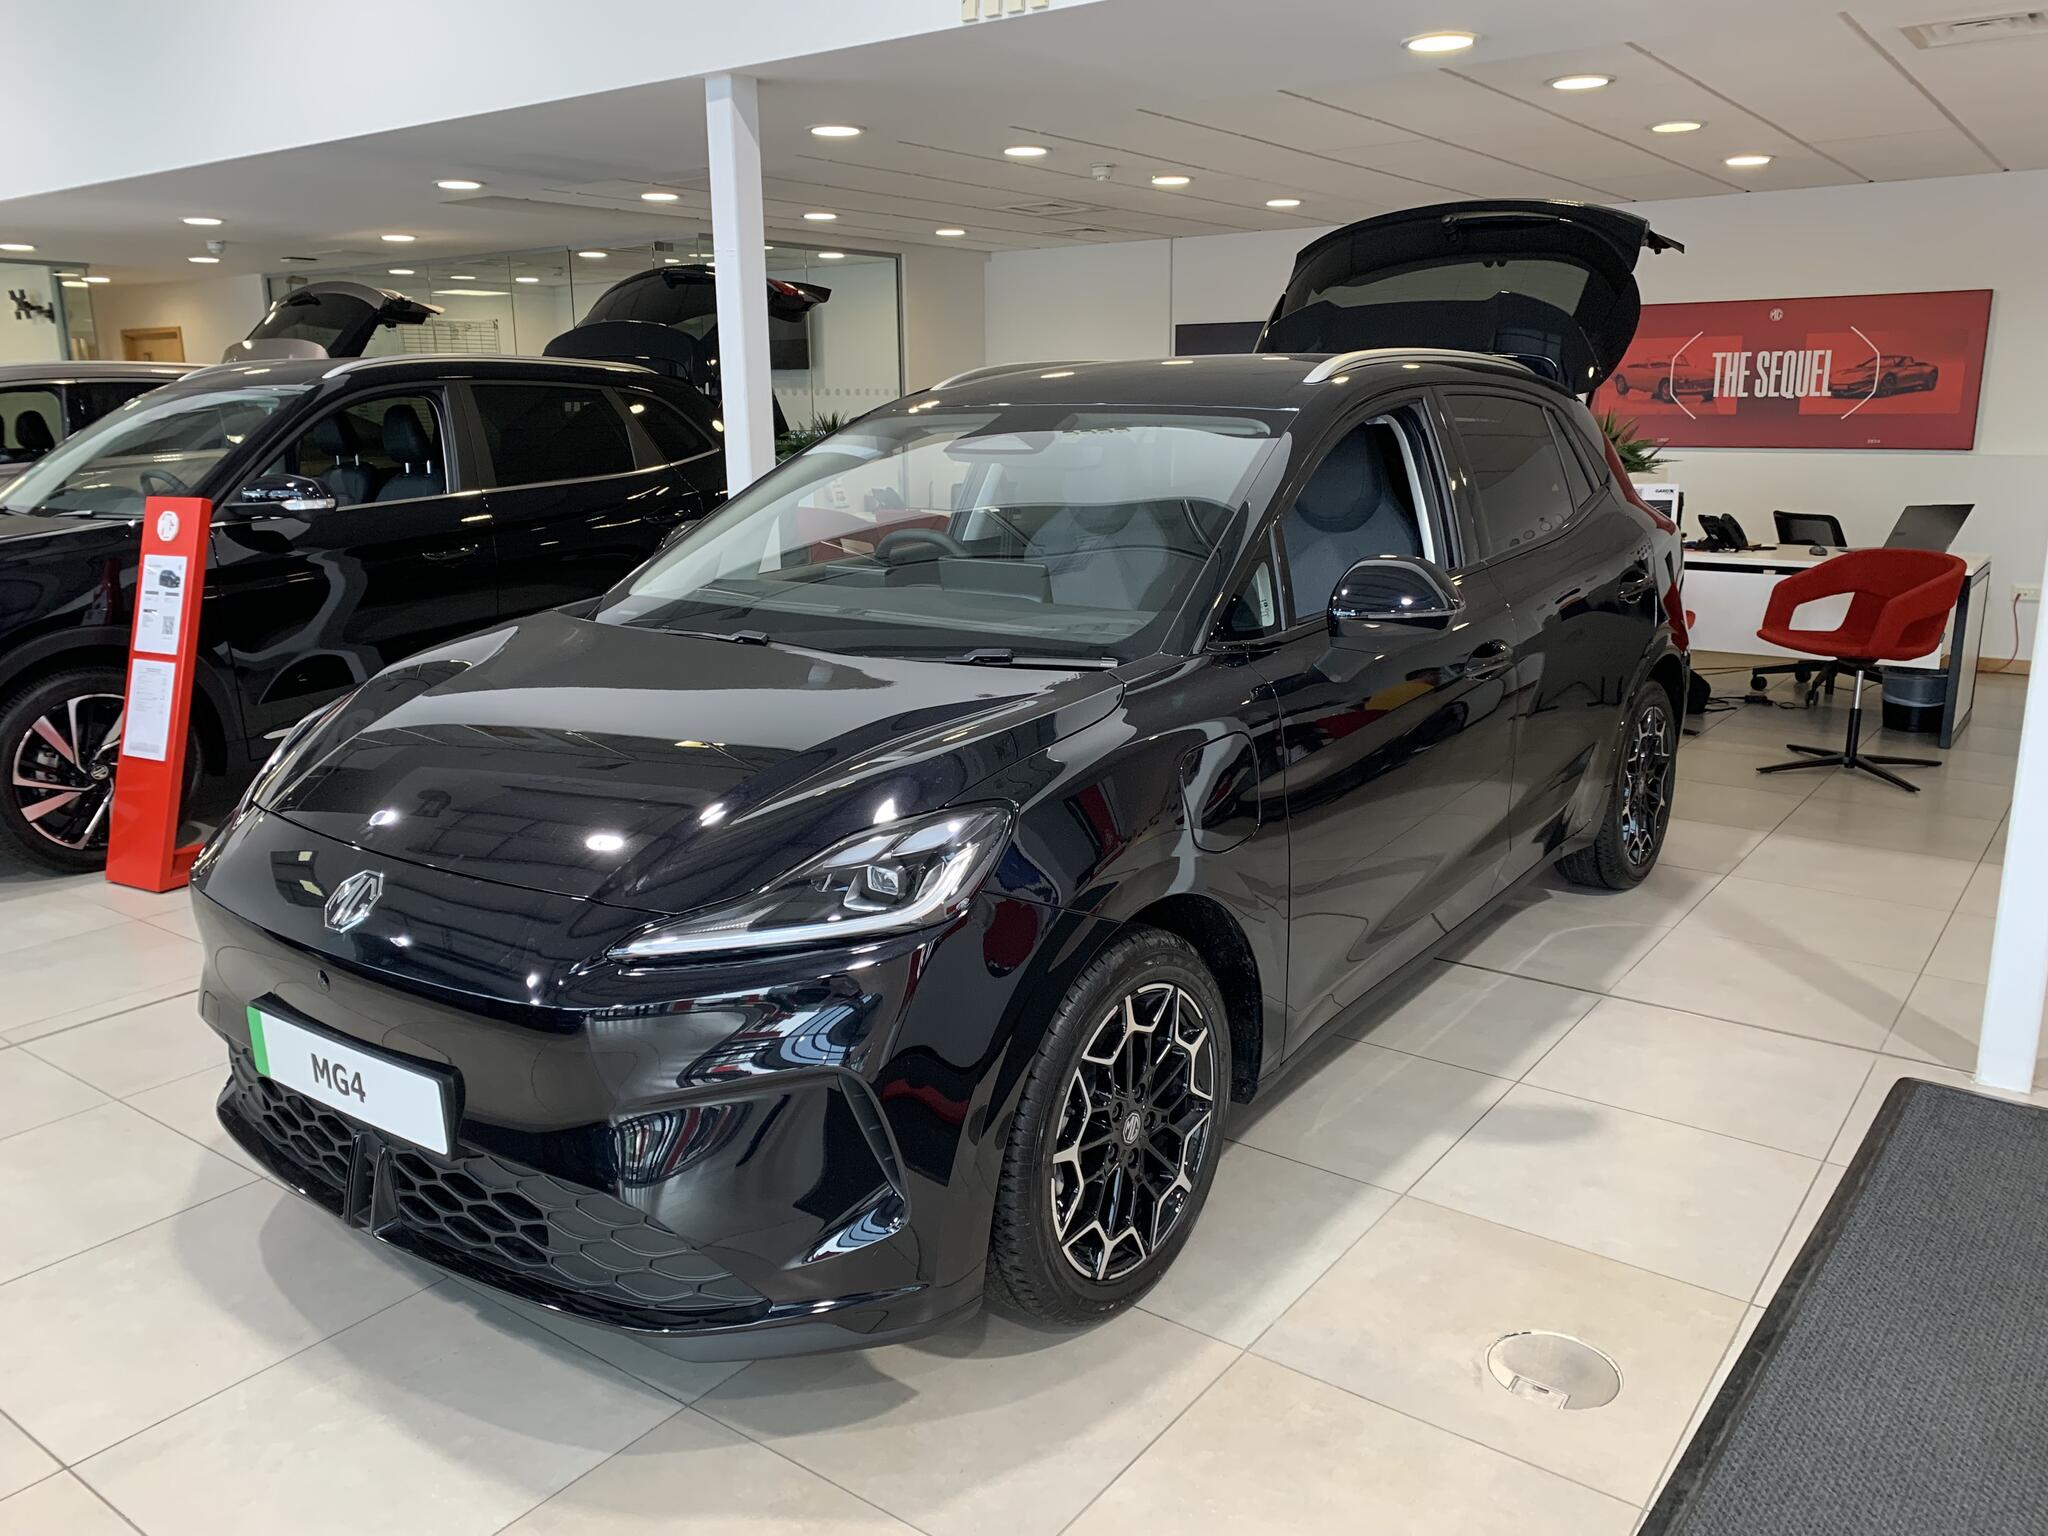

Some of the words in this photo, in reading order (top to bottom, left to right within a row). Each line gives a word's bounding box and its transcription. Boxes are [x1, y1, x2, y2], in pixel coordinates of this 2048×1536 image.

[1769, 308, 1783, 321] MG
[1712, 351, 1752, 398] THE
[1754, 349, 1832, 399] SEQUEL
[327, 872, 380, 930] MG
[310, 1052, 366, 1104] MG4
[1123, 1112, 1140, 1143] MG
